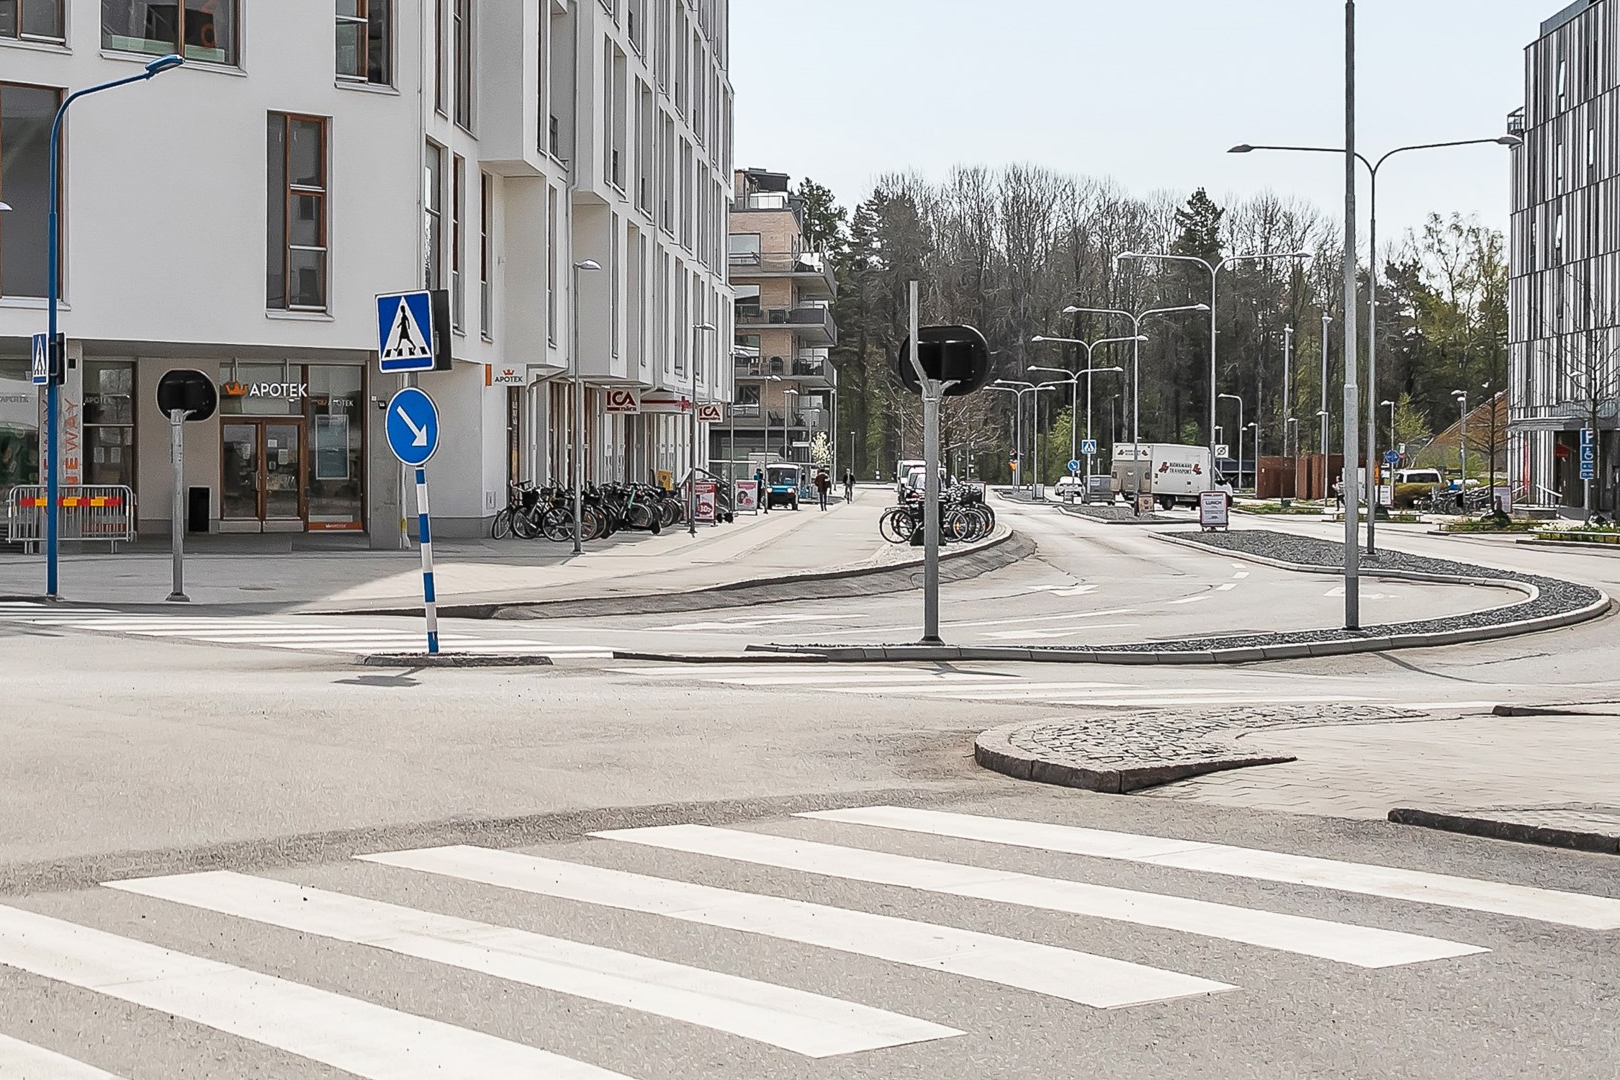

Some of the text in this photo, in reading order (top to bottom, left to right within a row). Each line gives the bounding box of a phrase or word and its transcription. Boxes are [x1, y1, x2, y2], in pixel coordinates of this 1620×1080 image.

[249, 383, 308, 397] APOTEK
[606, 391, 637, 406] ICA
[699, 405, 721, 417] ICA
